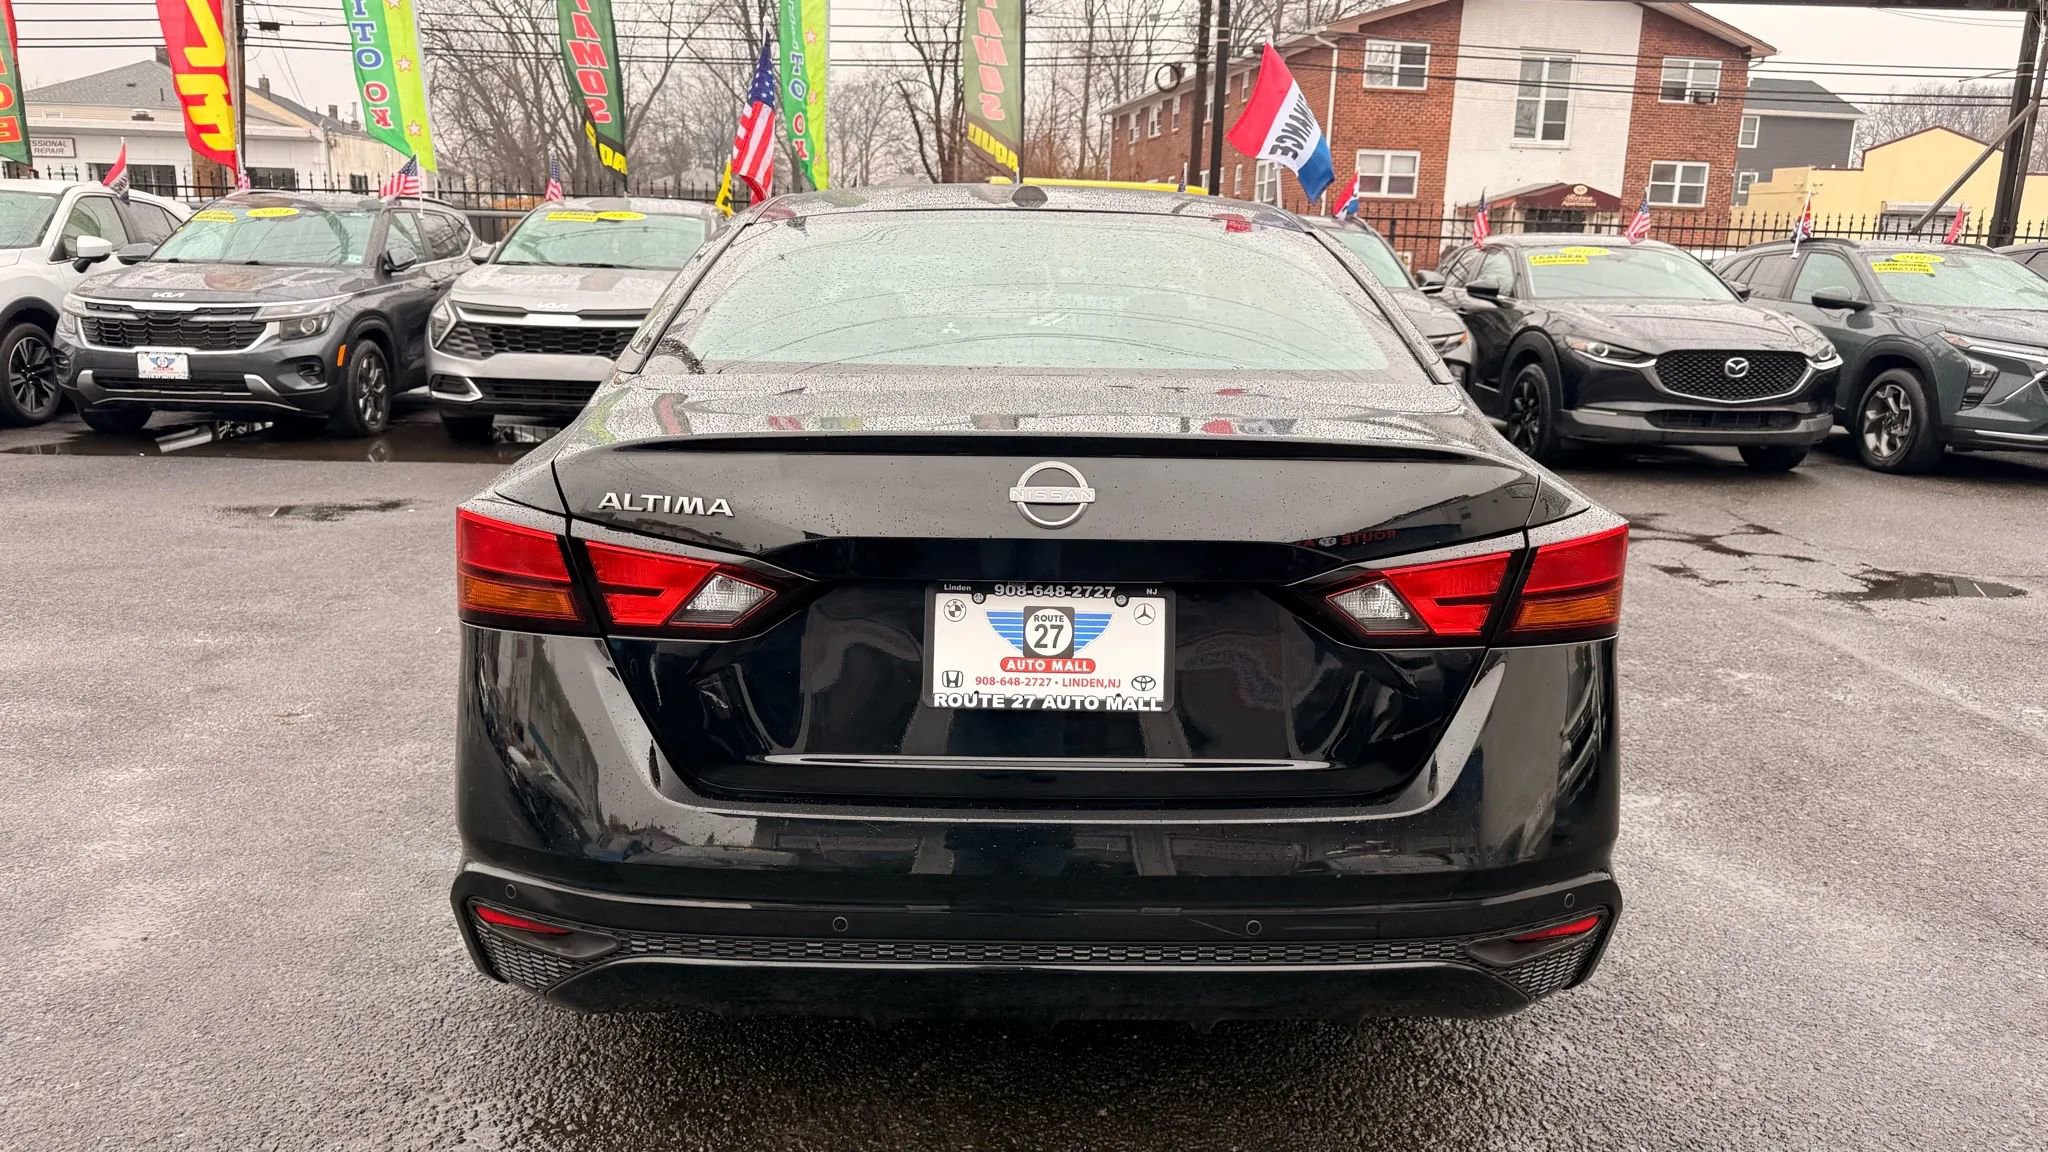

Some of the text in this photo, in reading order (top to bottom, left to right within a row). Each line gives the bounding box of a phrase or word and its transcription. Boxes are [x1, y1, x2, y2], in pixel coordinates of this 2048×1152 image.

[34, 147, 65, 155] REPAIR
[1011, 489, 1094, 501] NISSAN
[597, 492, 736, 517] ALTIMA
[943, 583, 972, 591] Linden
[994, 584, 1116, 598] 908-648-2727
[1033, 614, 1065, 623] ROUTE
[1033, 623, 1065, 649] 27
[1005, 659, 1091, 672] AUTO MALL
[975, 676, 1121, 689] 908-648-2727 LINDEN,NJ
[933, 693, 1163, 712] ROUTE 27 AUTO MALL
